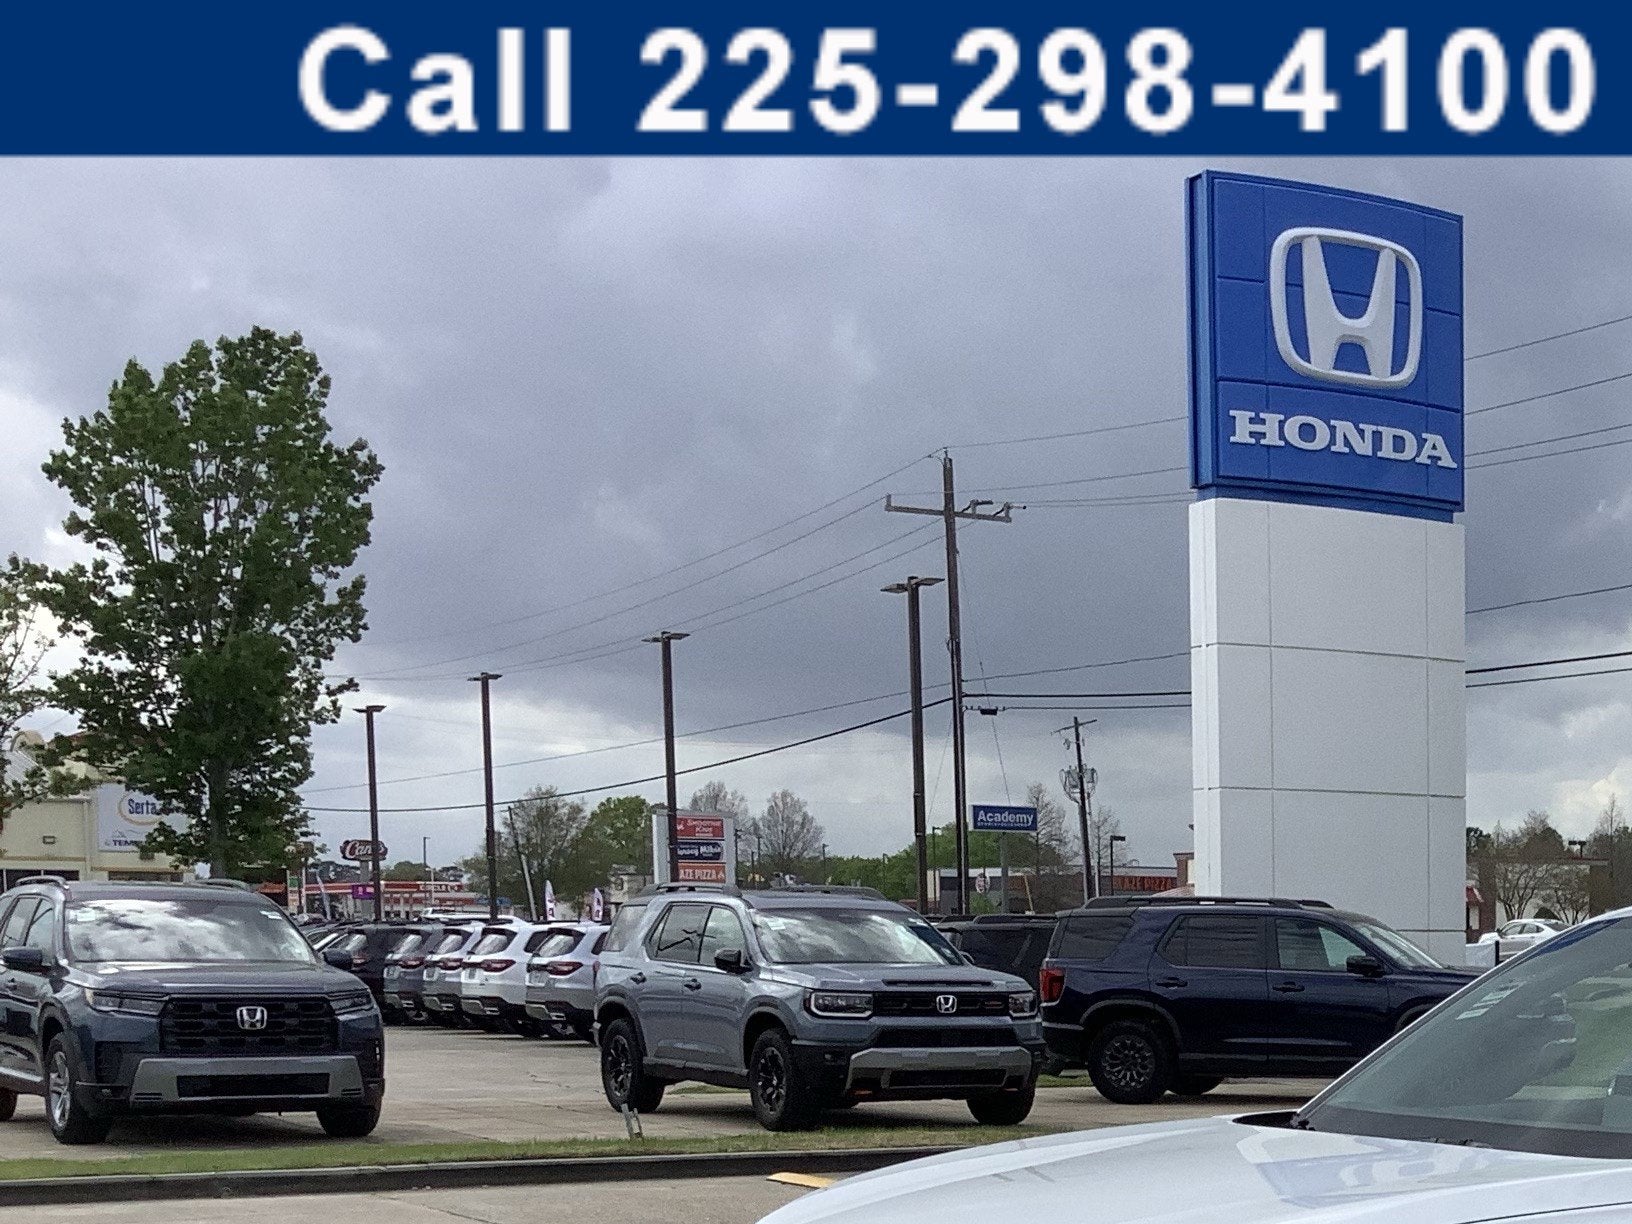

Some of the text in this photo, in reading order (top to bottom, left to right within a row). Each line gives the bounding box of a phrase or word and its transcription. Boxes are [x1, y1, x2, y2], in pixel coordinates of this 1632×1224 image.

[1229, 409, 1458, 469] HONDA
[127, 798, 157, 815] Serta
[977, 810, 1034, 827] Academy
